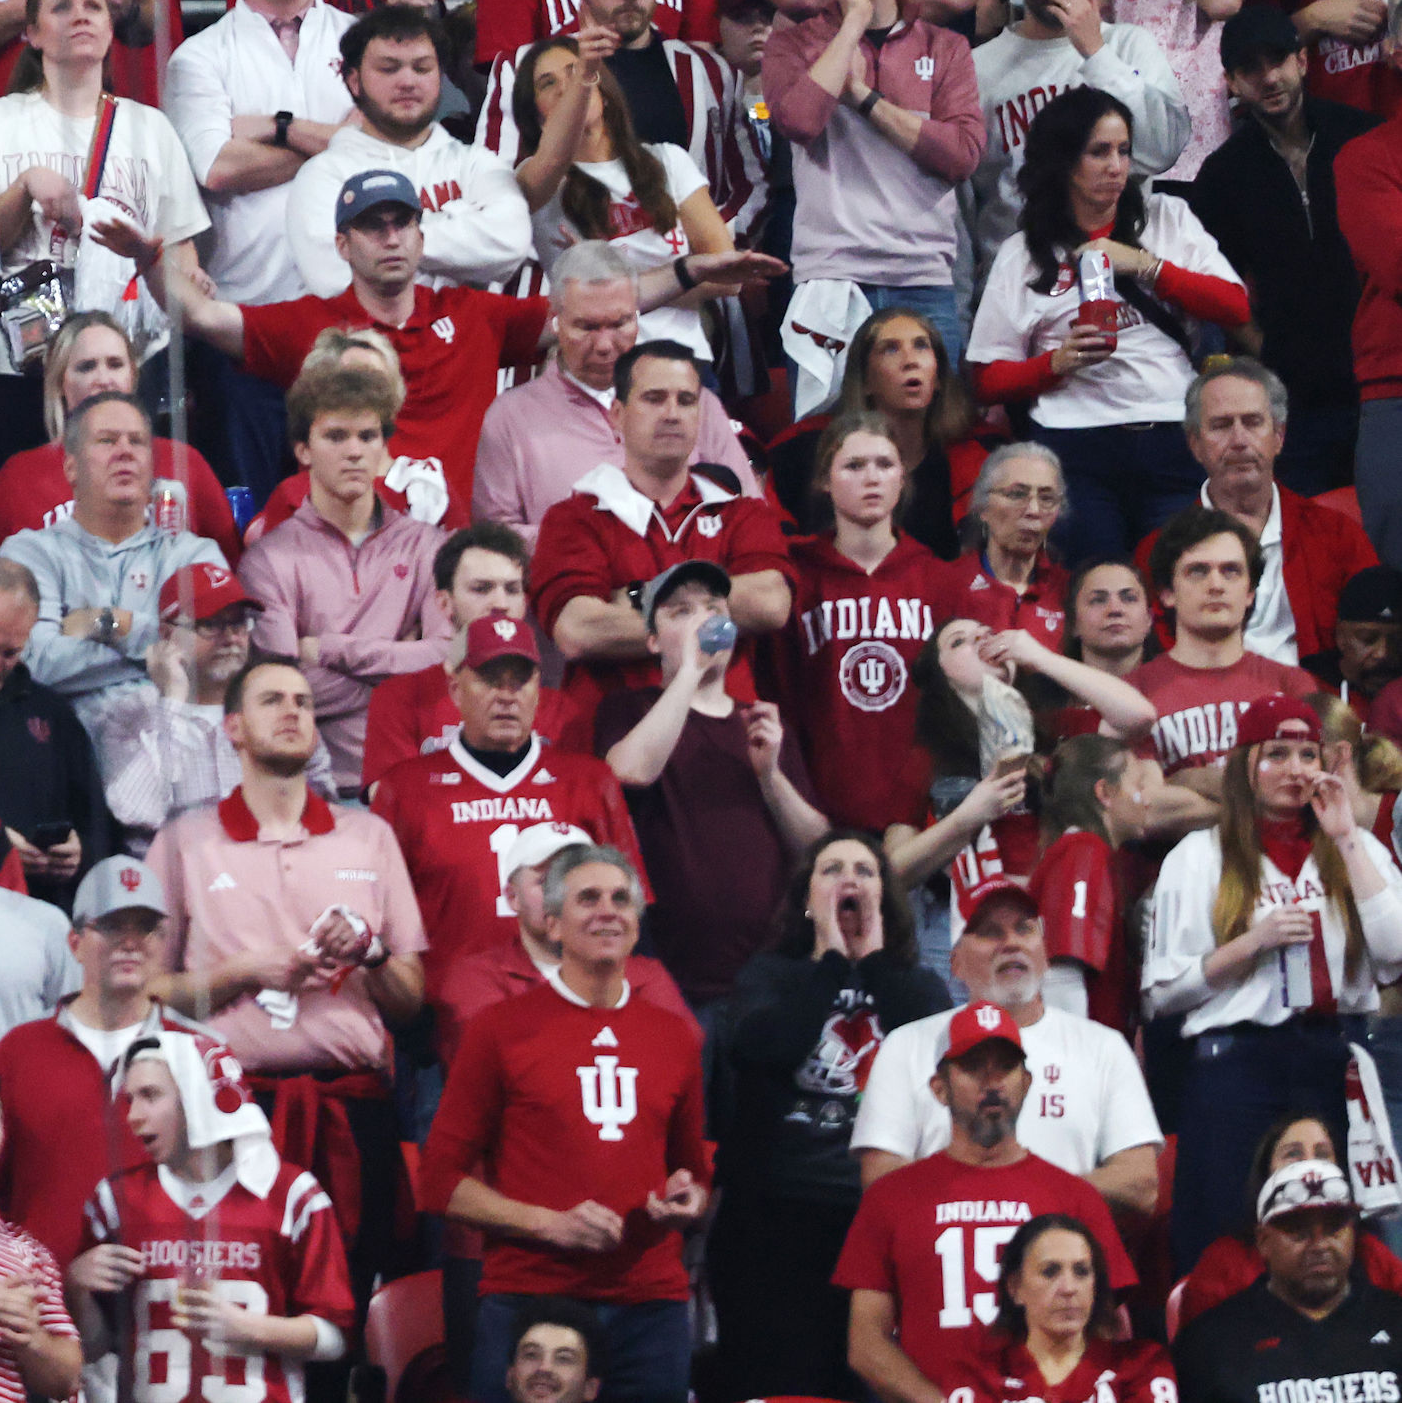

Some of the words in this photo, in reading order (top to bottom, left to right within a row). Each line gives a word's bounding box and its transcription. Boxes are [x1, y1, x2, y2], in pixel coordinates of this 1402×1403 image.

[451, 796, 554, 825] INDIANA
[1039, 1093, 1066, 1119] 15
[934, 1201, 1034, 1226] INDIANA
[141, 1239, 261, 1269] HOOSIERS
[934, 1225, 1011, 1329] 15
[1256, 1371, 1400, 1403] HOOSIERS
